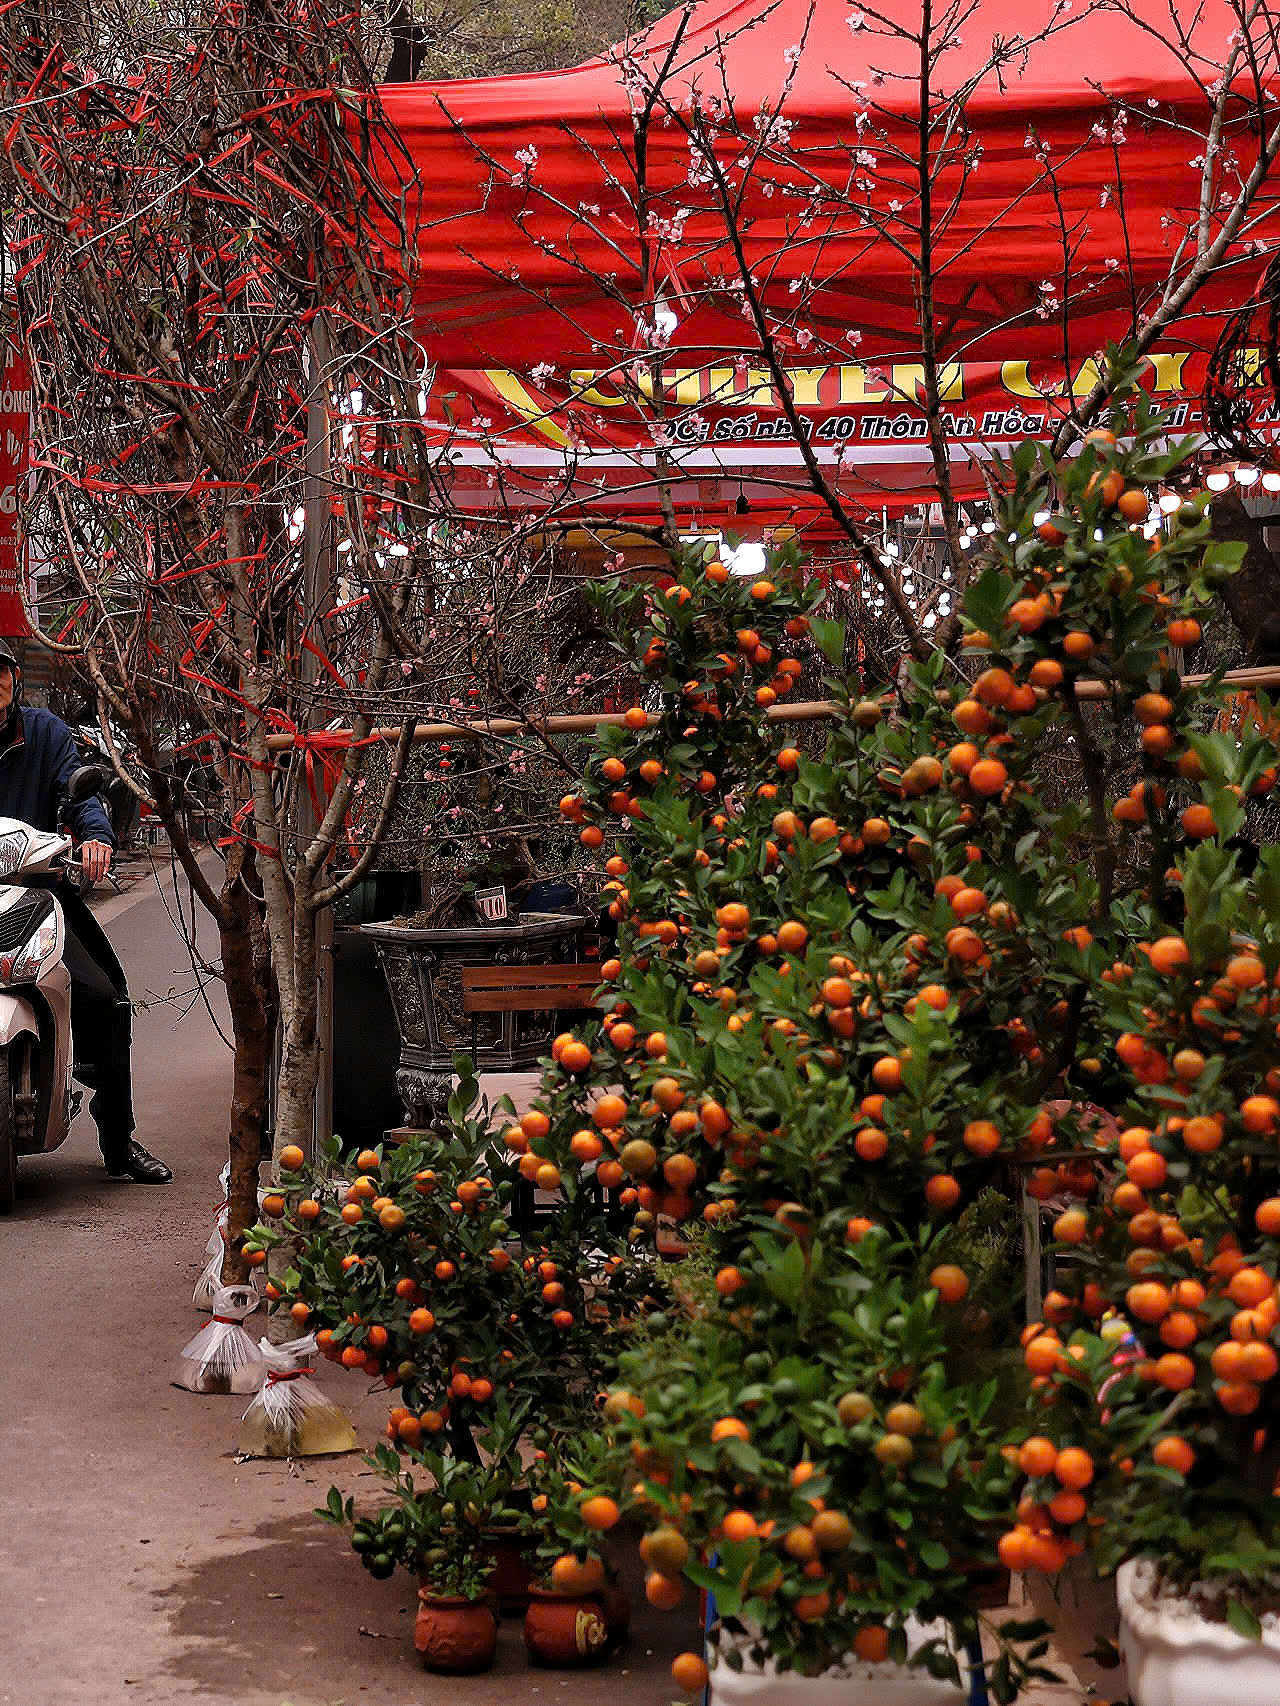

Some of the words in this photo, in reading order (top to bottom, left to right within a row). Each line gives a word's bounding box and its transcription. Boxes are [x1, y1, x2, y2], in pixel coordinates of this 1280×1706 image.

[713, 411, 758, 441] Số
[816, 416, 856, 440] 40
[859, 413, 929, 439] Thôn
